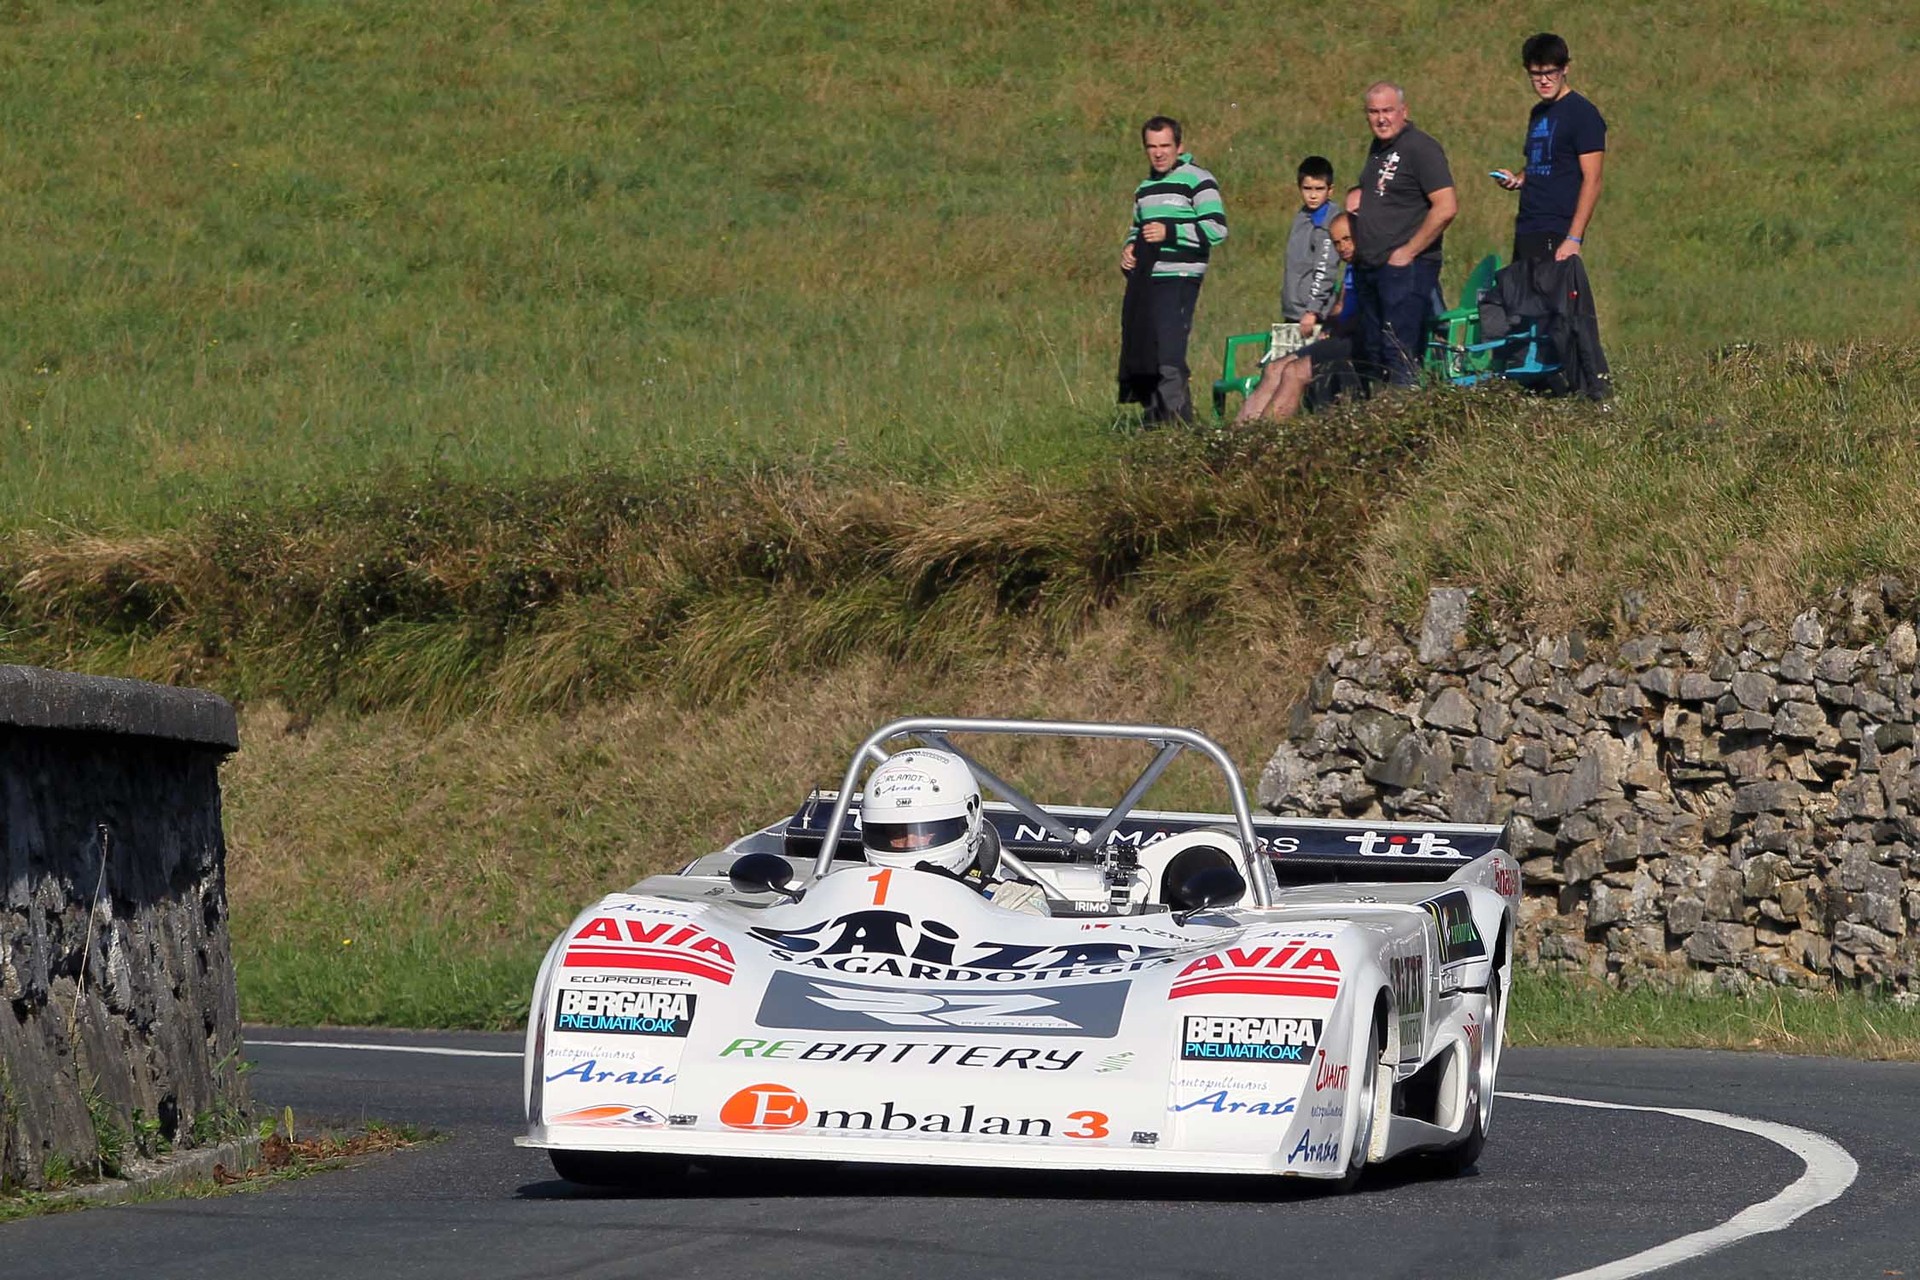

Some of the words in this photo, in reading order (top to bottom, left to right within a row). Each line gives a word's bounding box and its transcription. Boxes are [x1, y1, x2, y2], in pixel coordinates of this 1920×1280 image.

[868, 868, 893, 906] 1
[1074, 901, 1109, 913] IRIMO
[561, 990, 689, 1021] BERGARA
[559, 1014, 676, 1033] PNEUMATIKOAK
[1187, 1016, 1316, 1047] BERGARA
[719, 1038, 1084, 1071] REBATTERY
[1185, 1043, 1303, 1061] PNEUMATIKOAK
[1168, 1090, 1297, 1115] Arab
